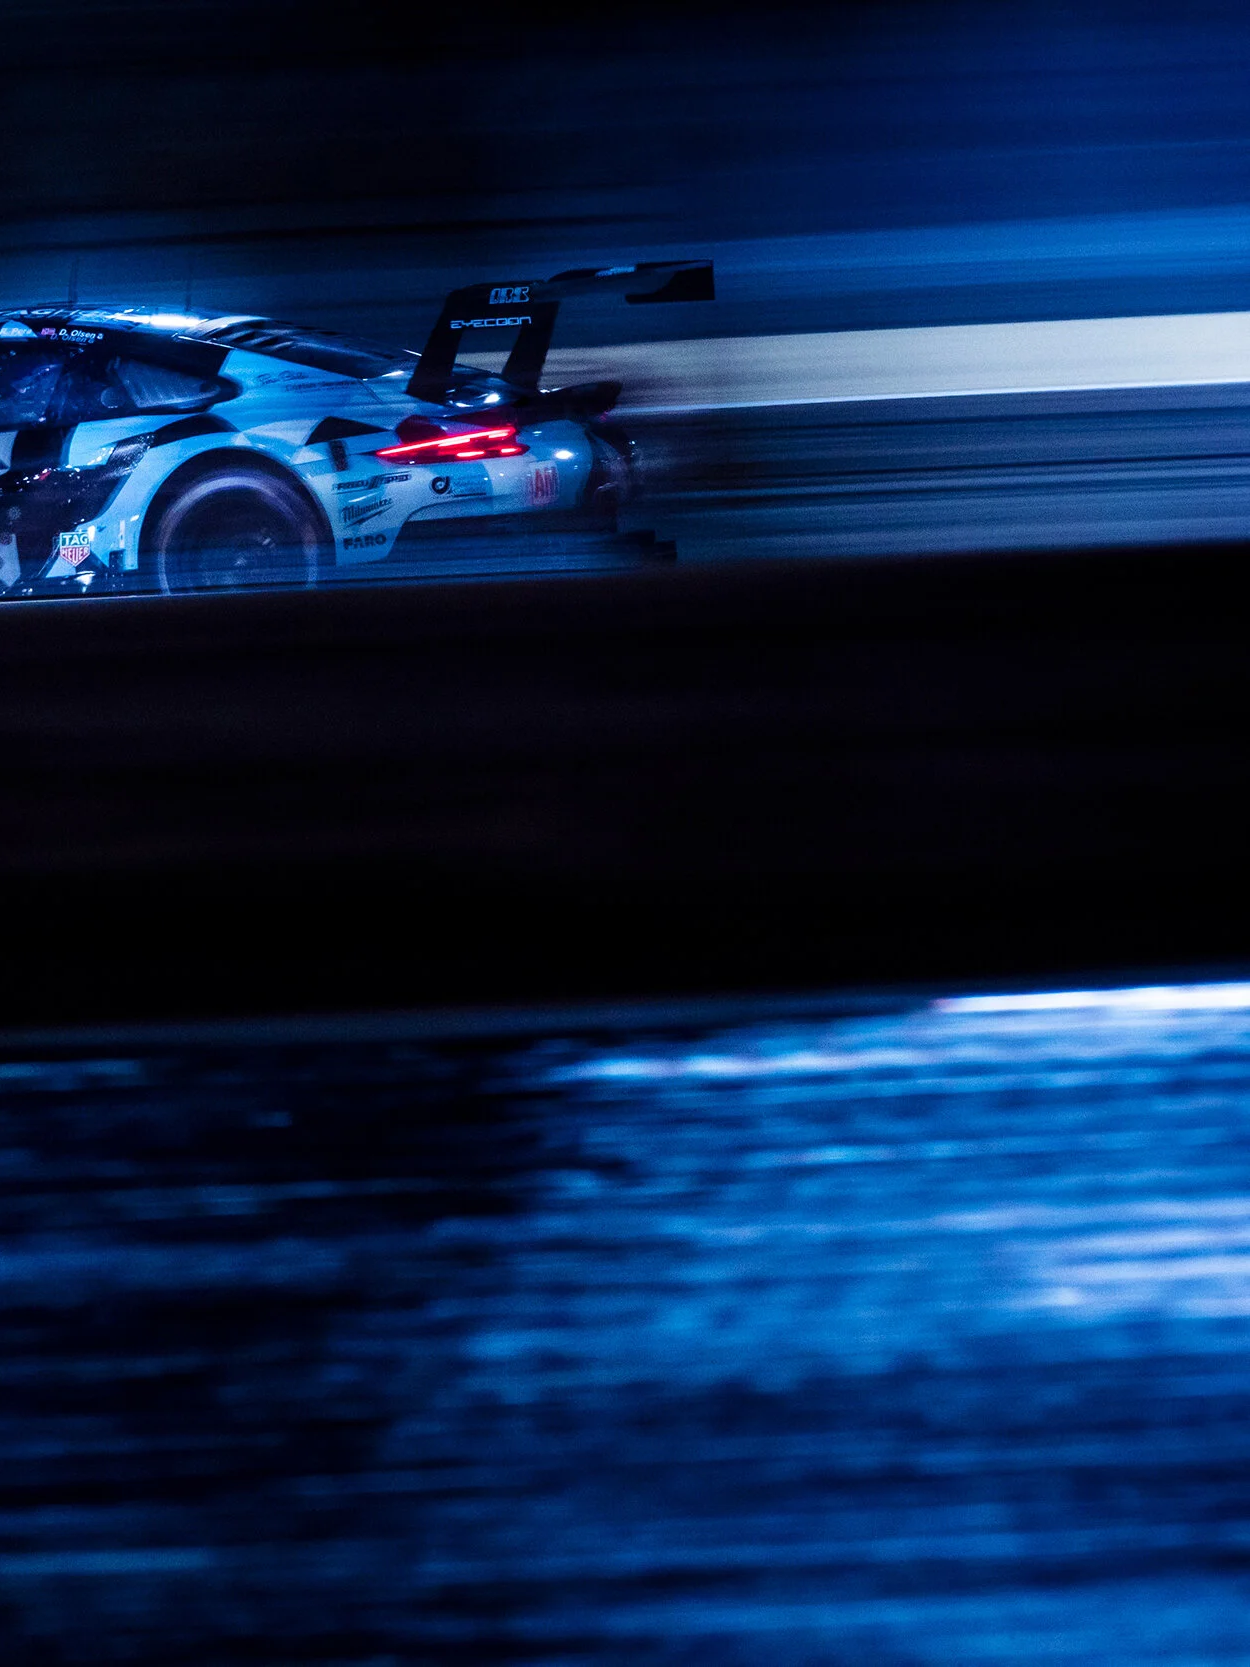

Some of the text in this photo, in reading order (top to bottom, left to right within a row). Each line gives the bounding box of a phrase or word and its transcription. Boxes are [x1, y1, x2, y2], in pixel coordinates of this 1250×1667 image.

[71, 329, 96, 339] Olsen
[62, 533, 89, 547] TAG
[343, 533, 387, 550] FARO
[60, 546, 90, 564] HEUER
